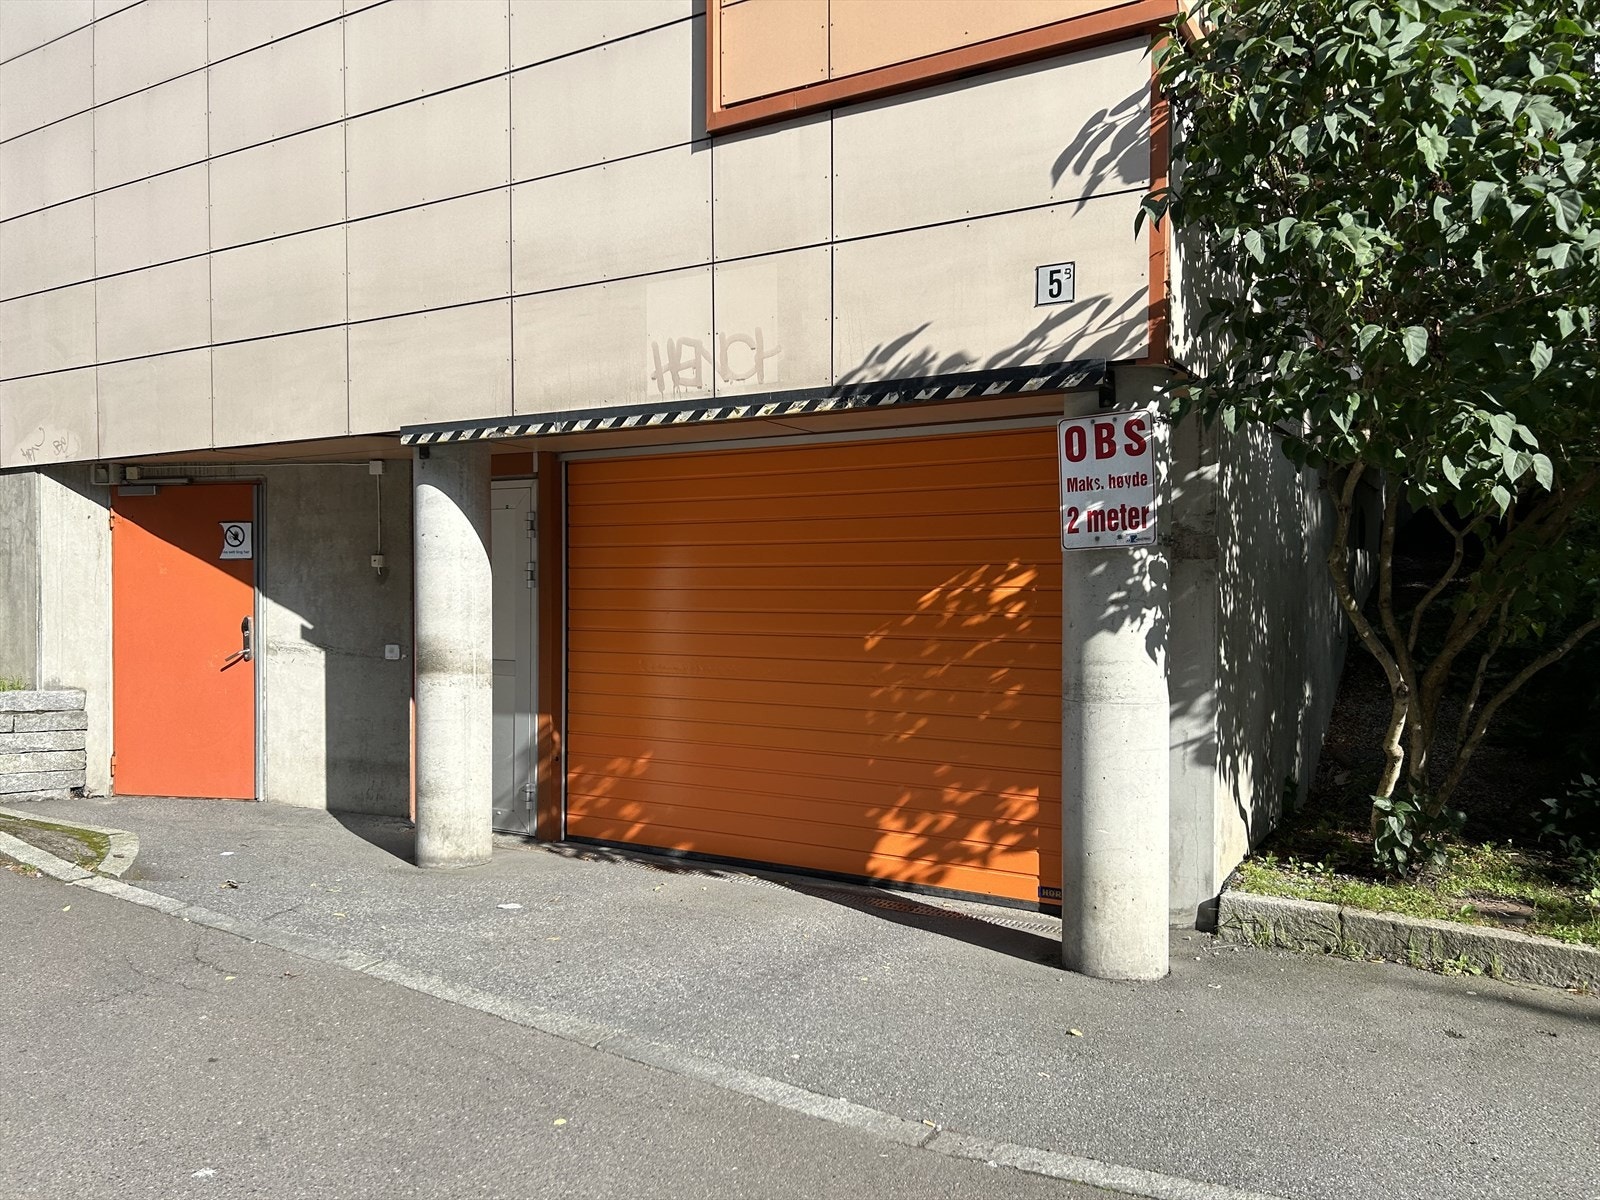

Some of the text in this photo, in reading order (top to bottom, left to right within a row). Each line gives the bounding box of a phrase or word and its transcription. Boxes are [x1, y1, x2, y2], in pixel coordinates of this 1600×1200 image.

[1065, 419, 1147, 462] OBS
[1067, 472, 1148, 492] Maks. høyde
[1067, 504, 1150, 534] 2 meter
